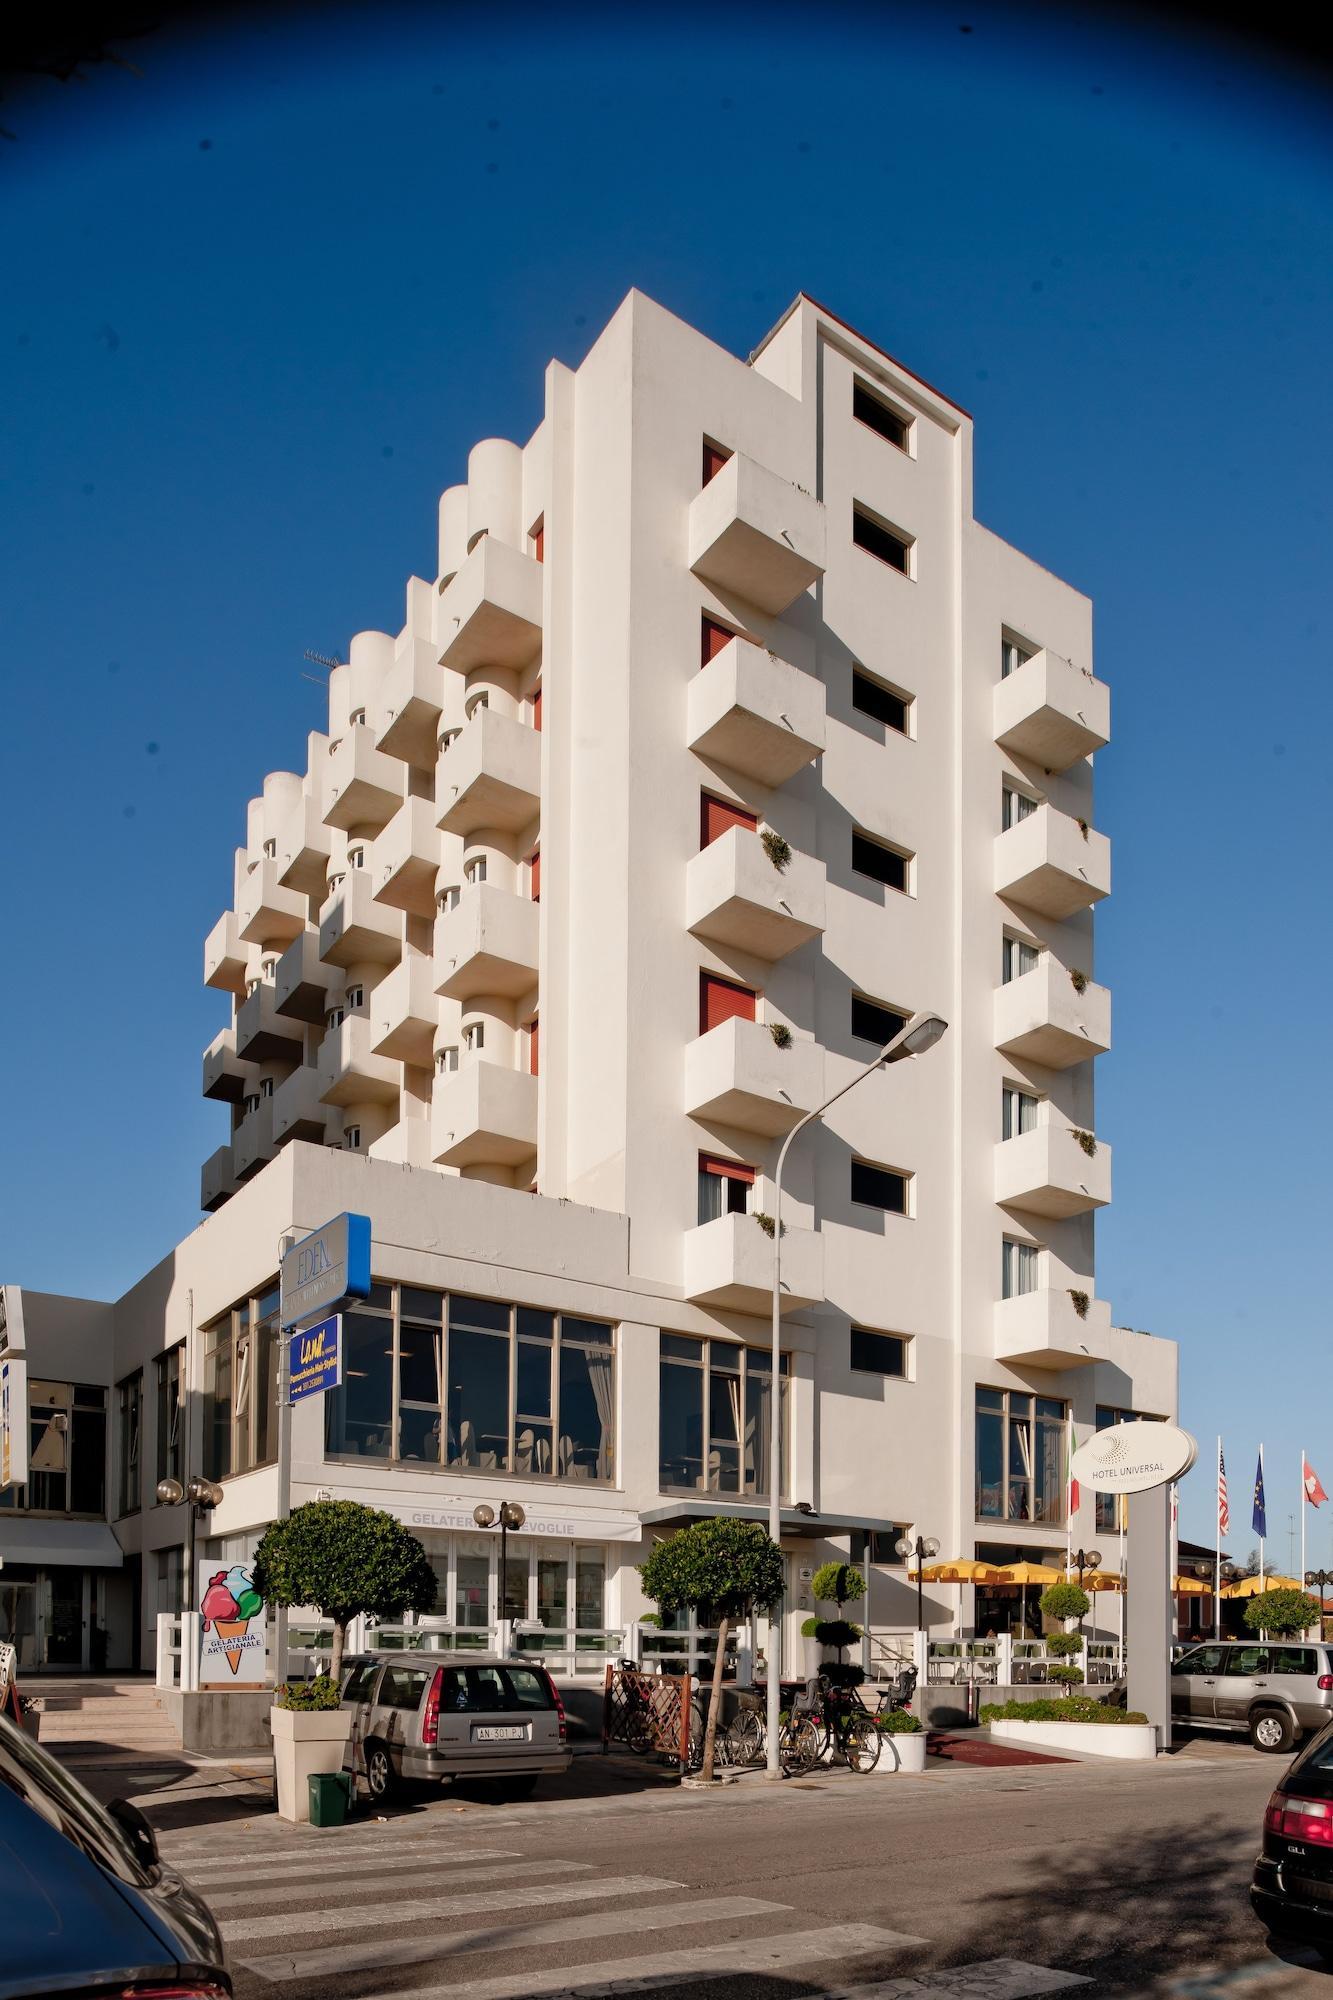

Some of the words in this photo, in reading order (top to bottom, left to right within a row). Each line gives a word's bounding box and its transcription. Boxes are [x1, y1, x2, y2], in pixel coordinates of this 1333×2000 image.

[297, 1233, 331, 1285] EDEN
[1092, 1468, 1118, 1480] HOTEL
[1120, 1463, 1164, 1476] UNIVERSAL
[208, 1640, 261, 1654] ARTIGIANALE
[211, 1634, 256, 1647] GELATERIA
